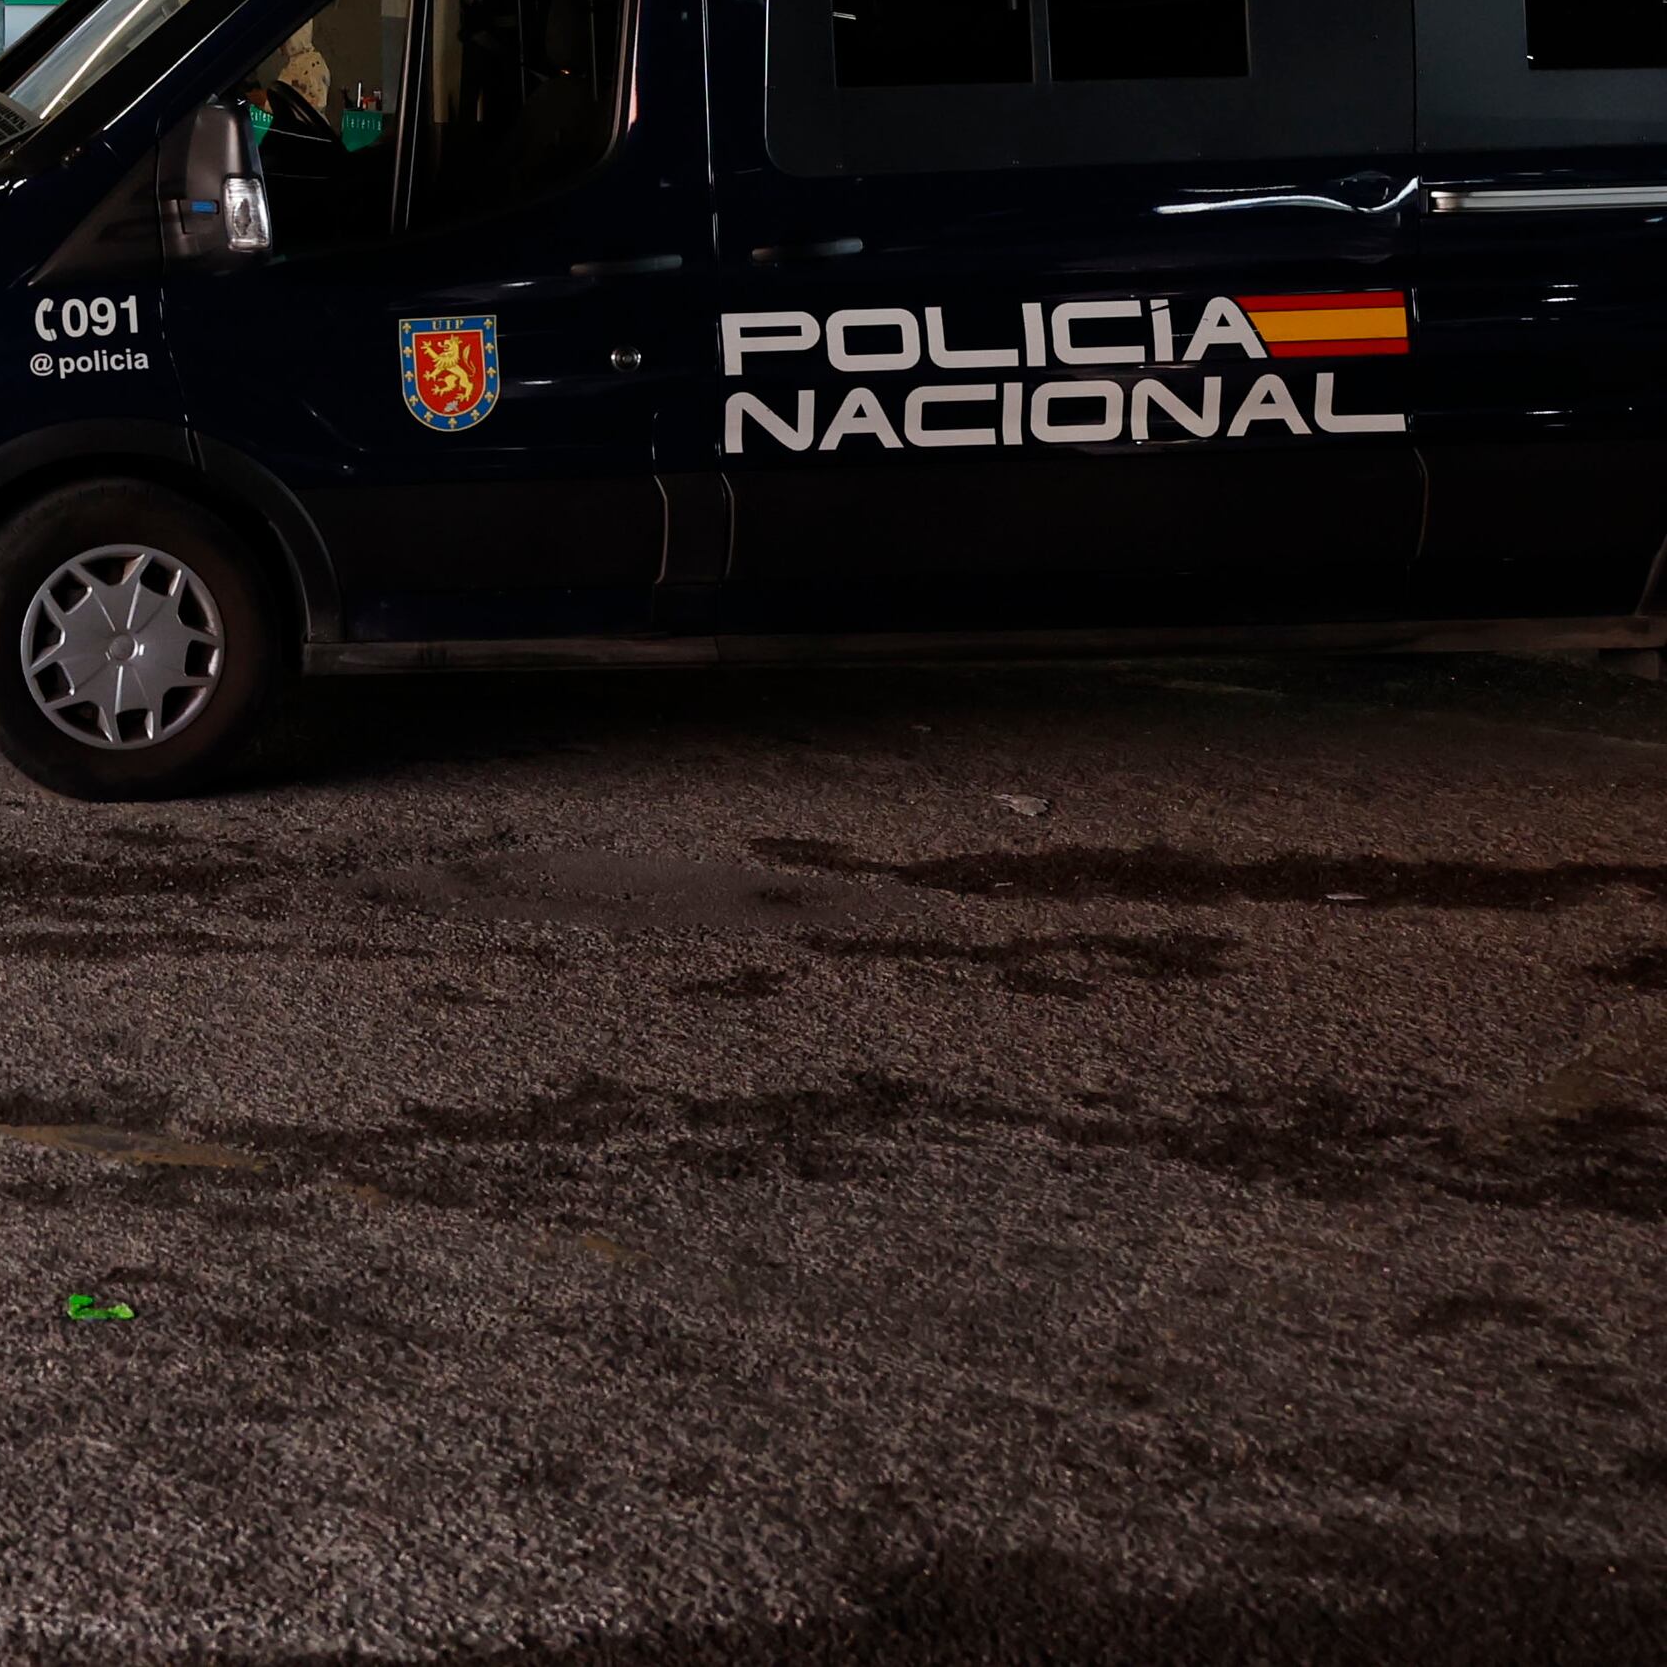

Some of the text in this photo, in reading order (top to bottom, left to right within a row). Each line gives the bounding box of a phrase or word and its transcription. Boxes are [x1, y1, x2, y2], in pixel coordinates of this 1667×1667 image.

[61, 296, 139, 338] 091
[432, 319, 464, 331] UIP
[29, 349, 150, 380] @policia
[724, 372, 1407, 454] NACIONAL
